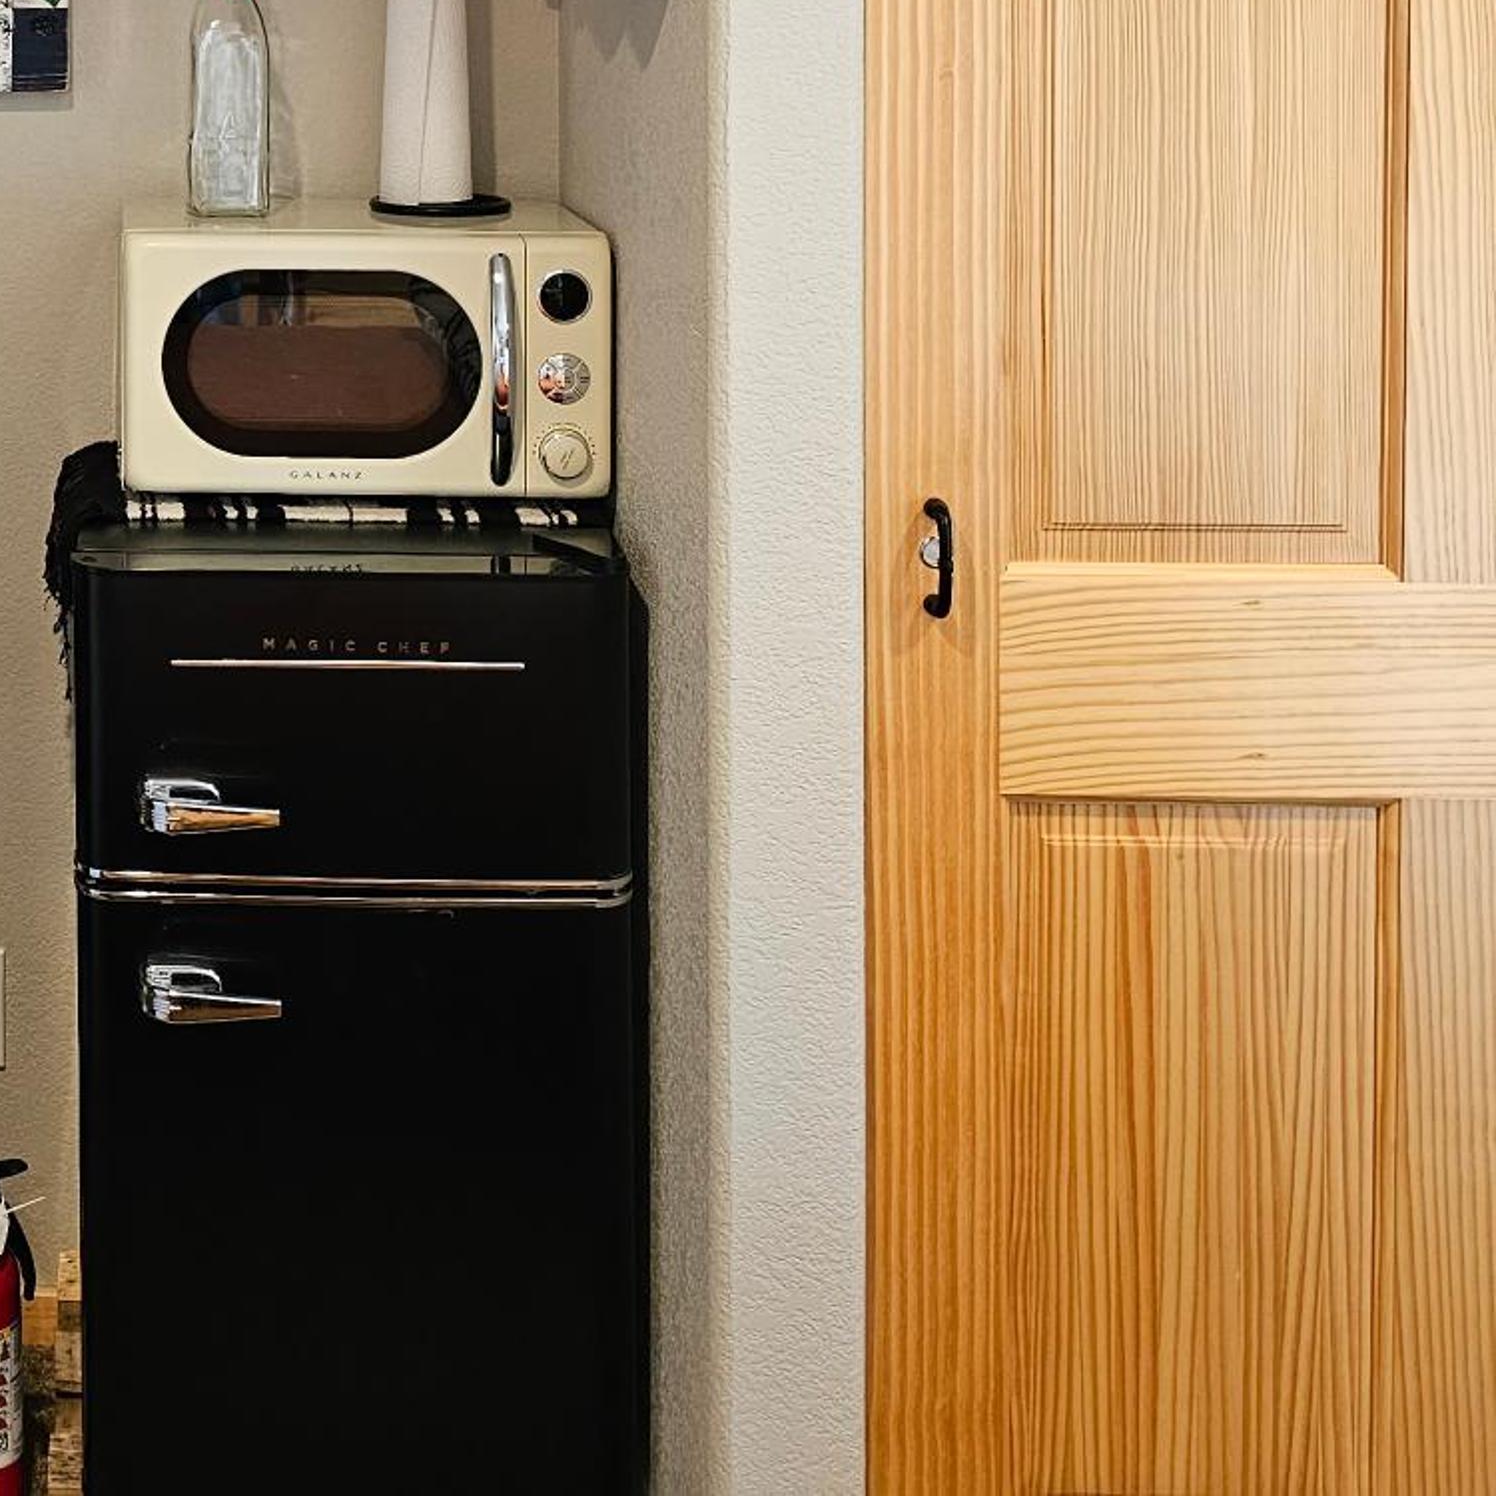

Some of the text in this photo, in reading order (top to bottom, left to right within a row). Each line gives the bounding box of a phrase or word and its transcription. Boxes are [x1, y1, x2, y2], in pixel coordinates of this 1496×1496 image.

[289, 470, 364, 480] GALANZ
[262, 637, 450, 654] MAGIC CHEF
